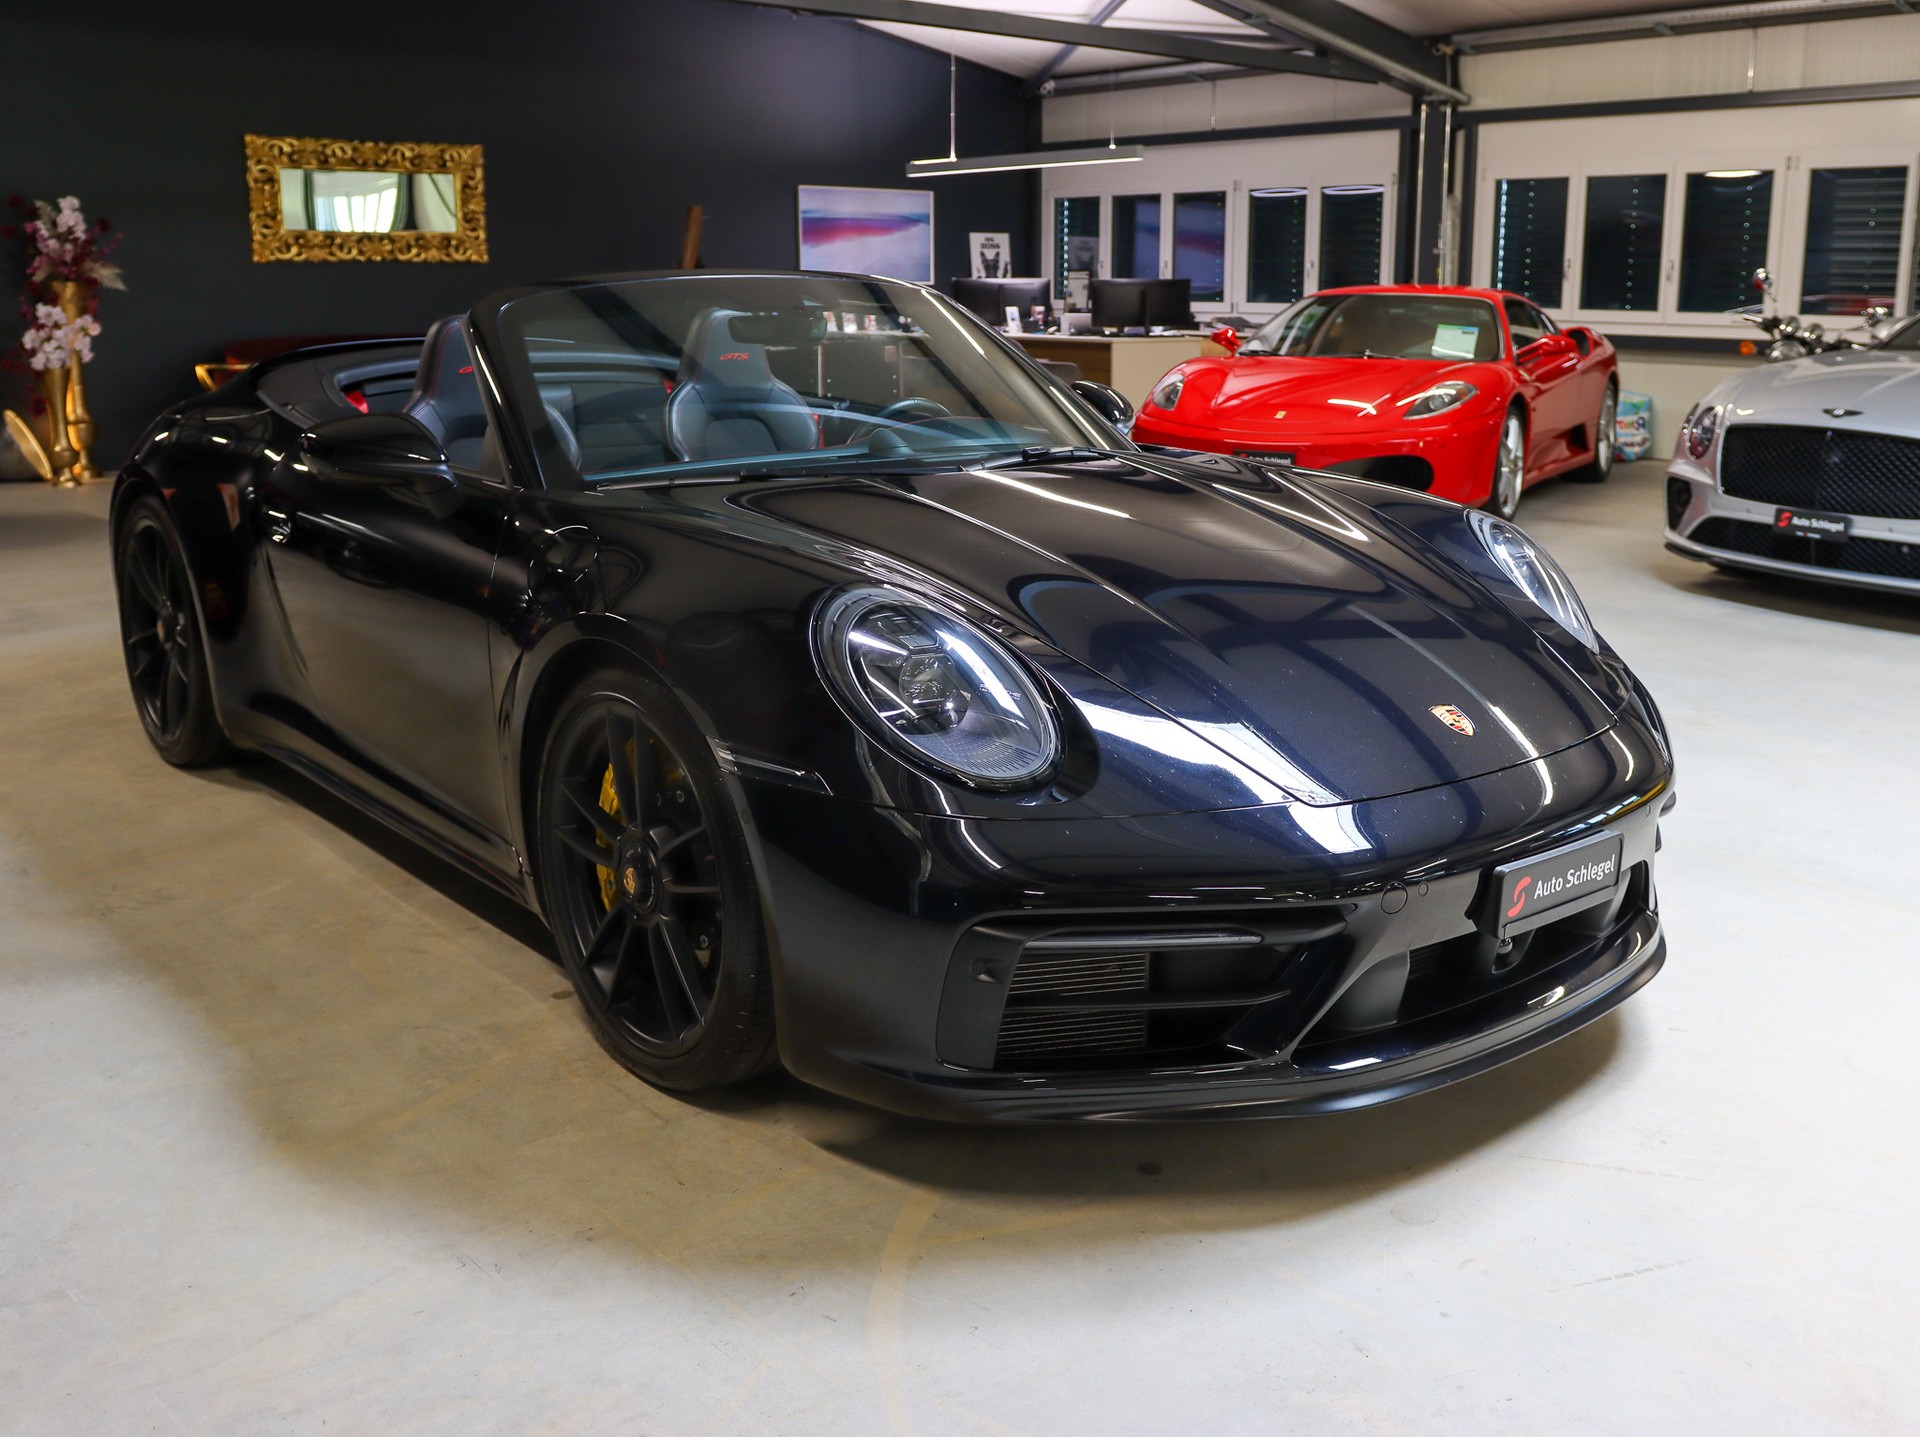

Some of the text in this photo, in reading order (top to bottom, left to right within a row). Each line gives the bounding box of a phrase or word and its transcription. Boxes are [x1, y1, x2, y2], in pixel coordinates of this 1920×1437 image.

[720, 353, 748, 361] GTS
[1791, 516, 1845, 533] Auto Schlegel
[1533, 854, 1615, 899] Auto Schlegel
